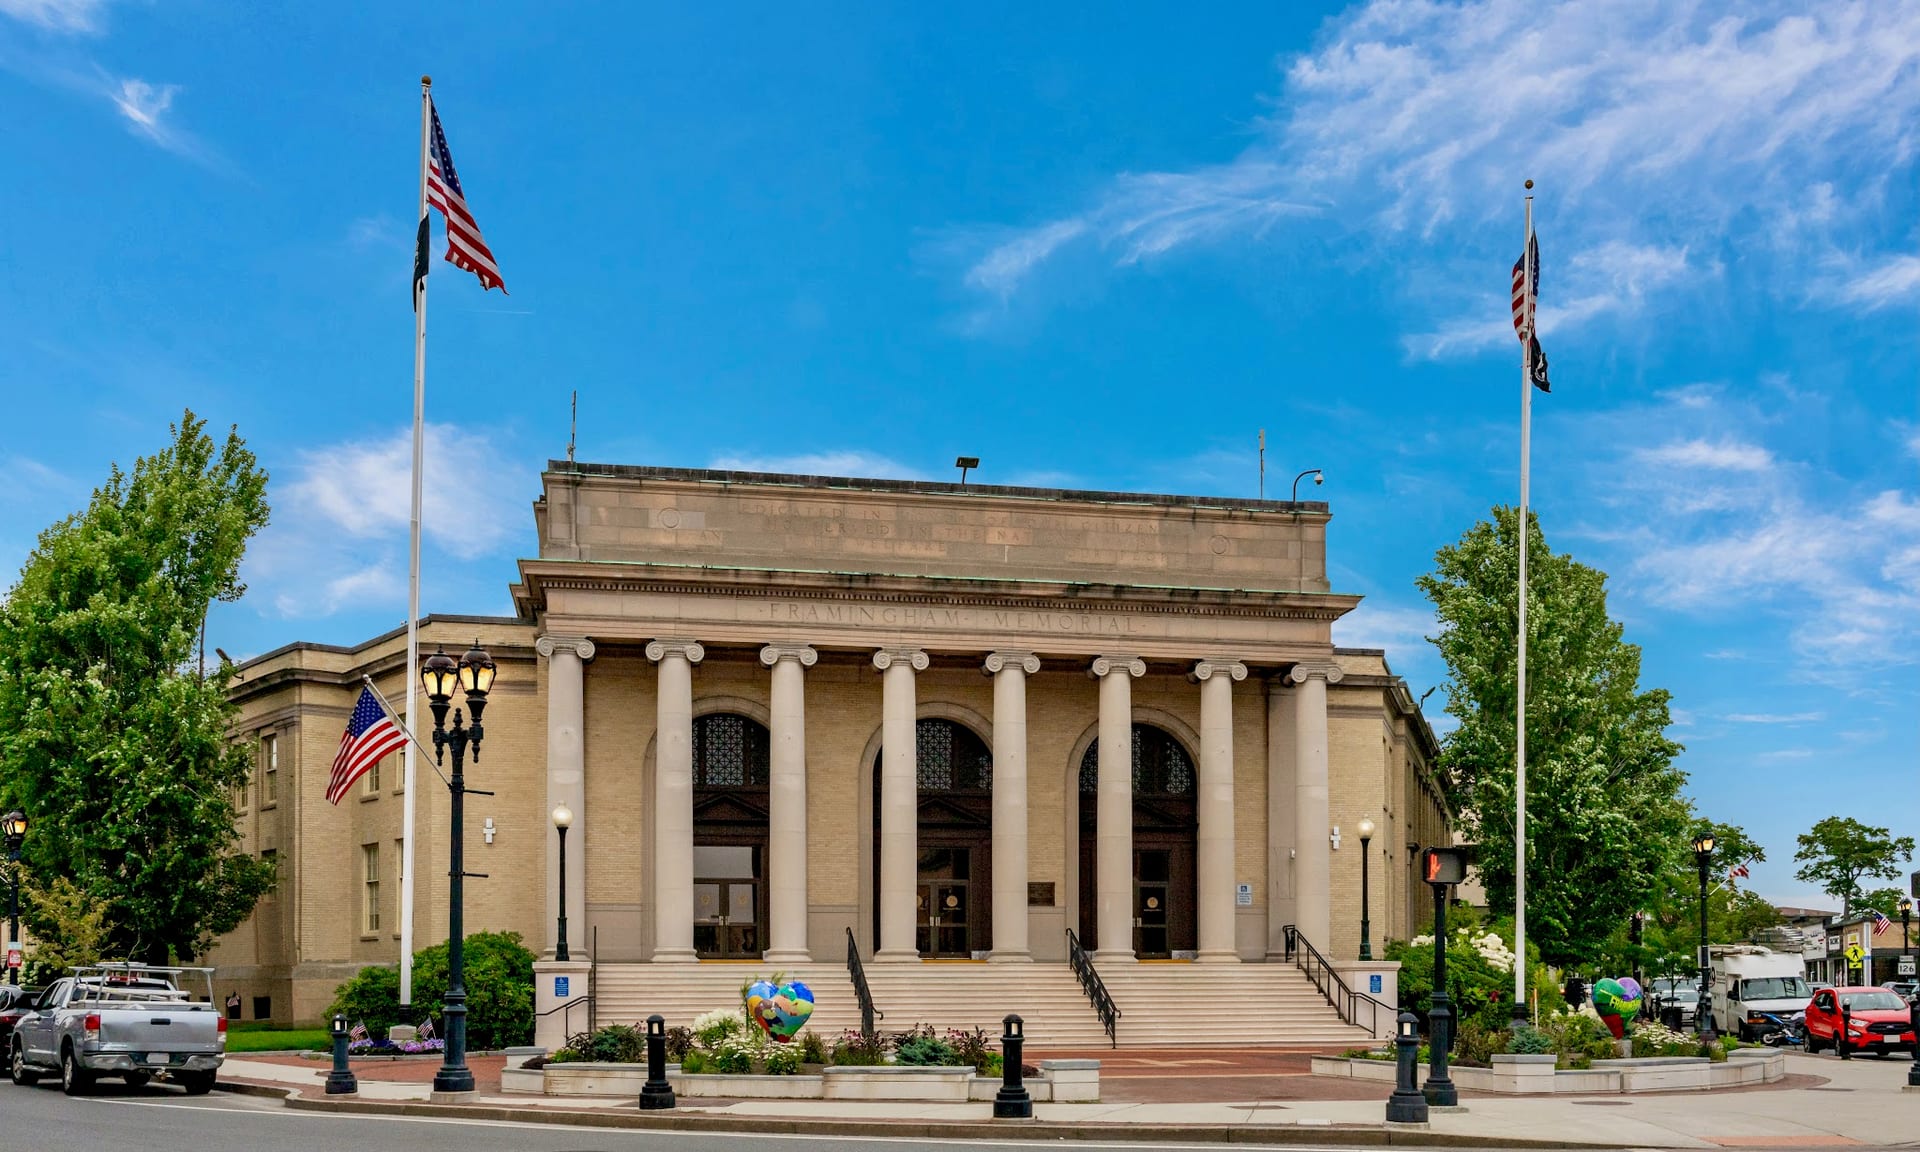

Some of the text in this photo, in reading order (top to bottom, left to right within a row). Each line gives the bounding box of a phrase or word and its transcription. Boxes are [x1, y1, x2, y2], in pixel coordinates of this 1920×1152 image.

[727, 503, 843, 518] EDICATED
[863, 510, 881, 520] IN
[770, 602, 1137, 632] FRAMINGHAM MEMORIAL
[1899, 965, 1914, 973] 126
